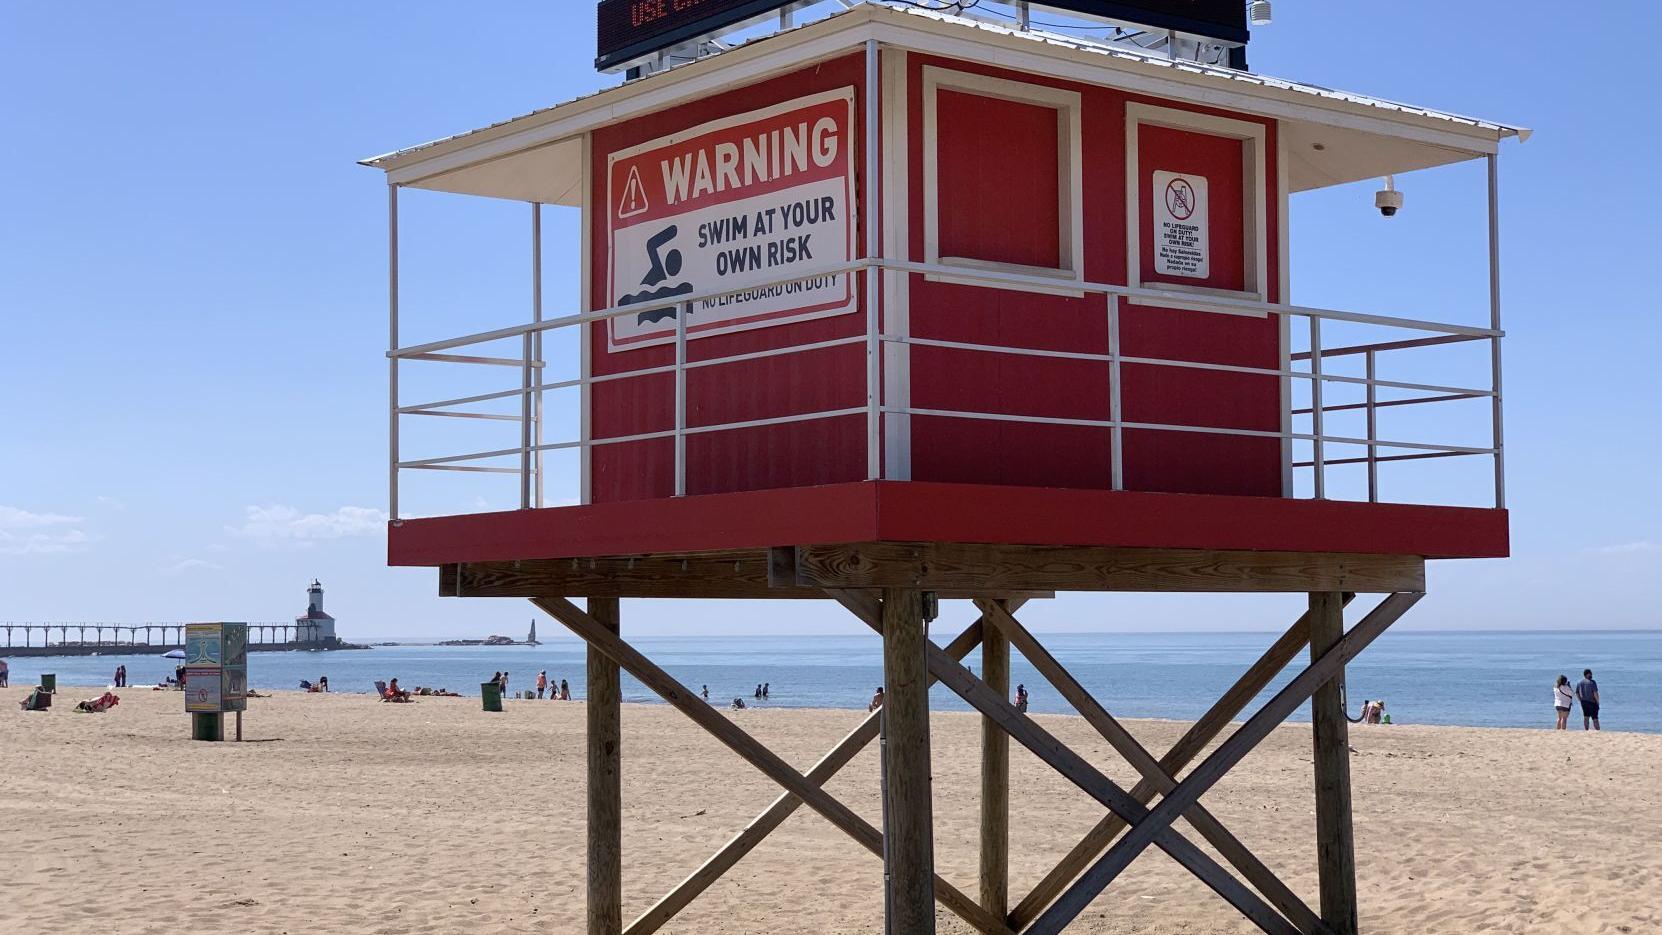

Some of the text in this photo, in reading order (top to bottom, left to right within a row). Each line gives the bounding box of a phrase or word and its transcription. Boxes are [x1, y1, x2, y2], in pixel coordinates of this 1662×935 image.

[632, 0, 667, 26] USE
[661, 117, 838, 205] WARNING
[698, 196, 836, 248] SWIM AT YOUR
[1172, 223, 1199, 231] LIFEGUARD
[716, 234, 812, 277] OWN RISK
[702, 275, 837, 309] NO LIFEGUARD ON DUTY
